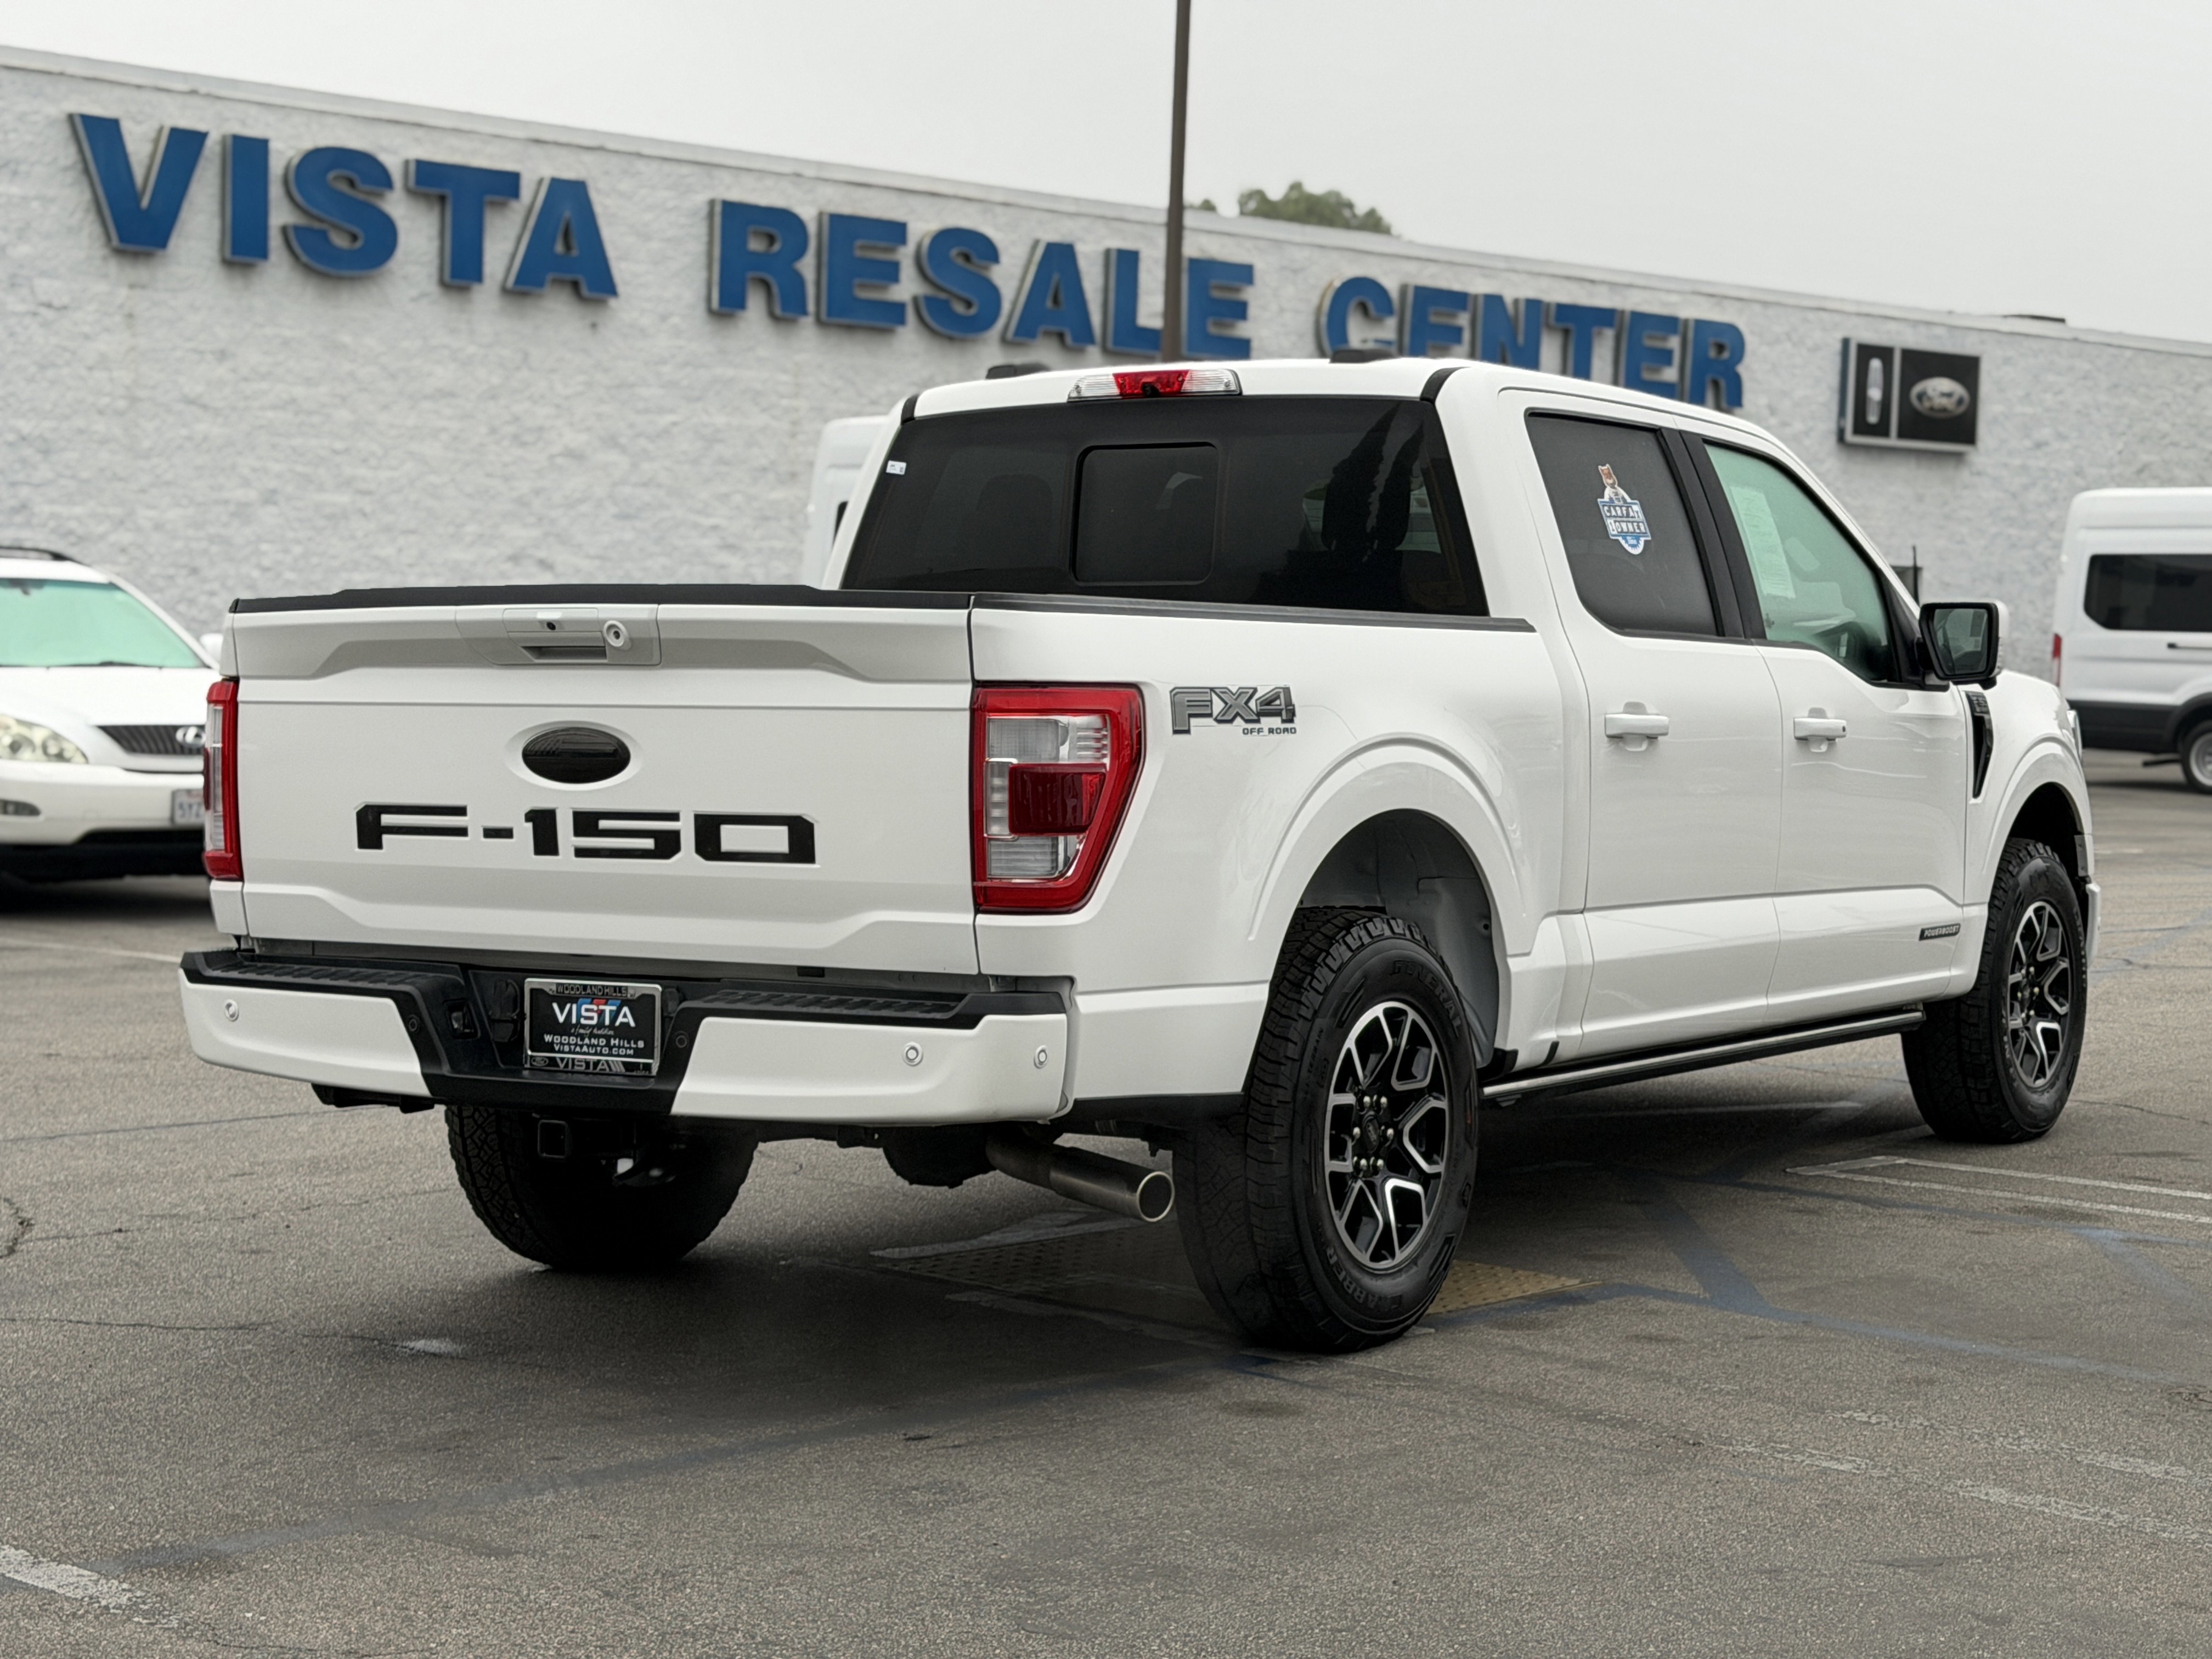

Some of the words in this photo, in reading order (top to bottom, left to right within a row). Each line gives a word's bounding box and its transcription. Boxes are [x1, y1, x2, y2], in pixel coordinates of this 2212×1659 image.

[70, 112, 618, 298] VISTA
[709, 199, 1254, 359] RESALE
[1318, 276, 1745, 410] CENTER
[1603, 505, 1643, 520] CARFAX
[1615, 522, 1646, 533] OWNER
[1169, 686, 1296, 735] FX4
[356, 804, 816, 865] F-150
[1924, 925, 1960, 938] POWERBOOST
[557, 984, 603, 996] WOODLAND
[605, 986, 627, 997] HILLS
[552, 1002, 636, 1027] VISTA
[544, 1034, 606, 1046] WOODLAND
[611, 1037, 644, 1048] HILLS
[556, 1057, 609, 1072] VISTA
